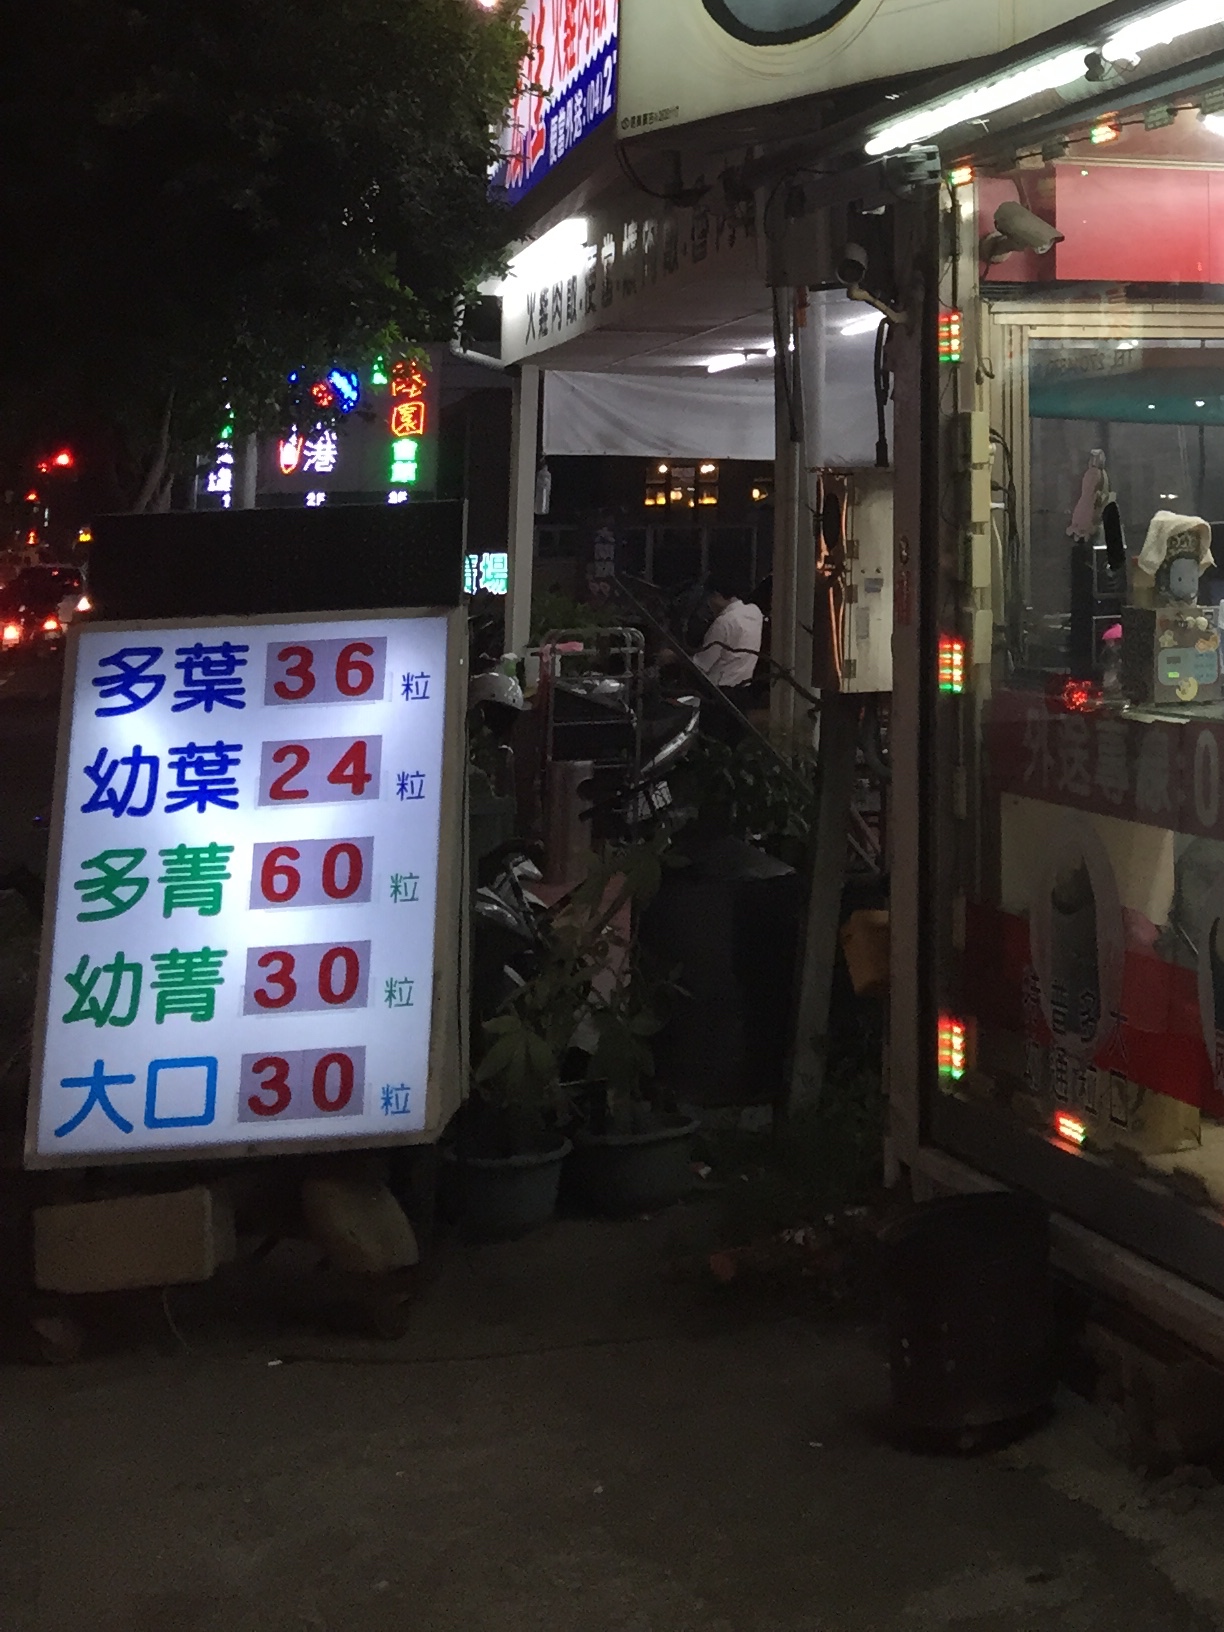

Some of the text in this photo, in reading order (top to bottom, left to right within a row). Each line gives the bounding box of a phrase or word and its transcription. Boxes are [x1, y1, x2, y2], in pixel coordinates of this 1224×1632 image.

[92, 641, 431, 717] 多葉 36 粒
[80, 739, 426, 818] 幼葉 24 粒
[74, 841, 420, 923] 多菁 60 粒
[62, 946, 415, 1028] 幼菁 30 粒
[54, 1052, 411, 1138] 大口 30 粒
